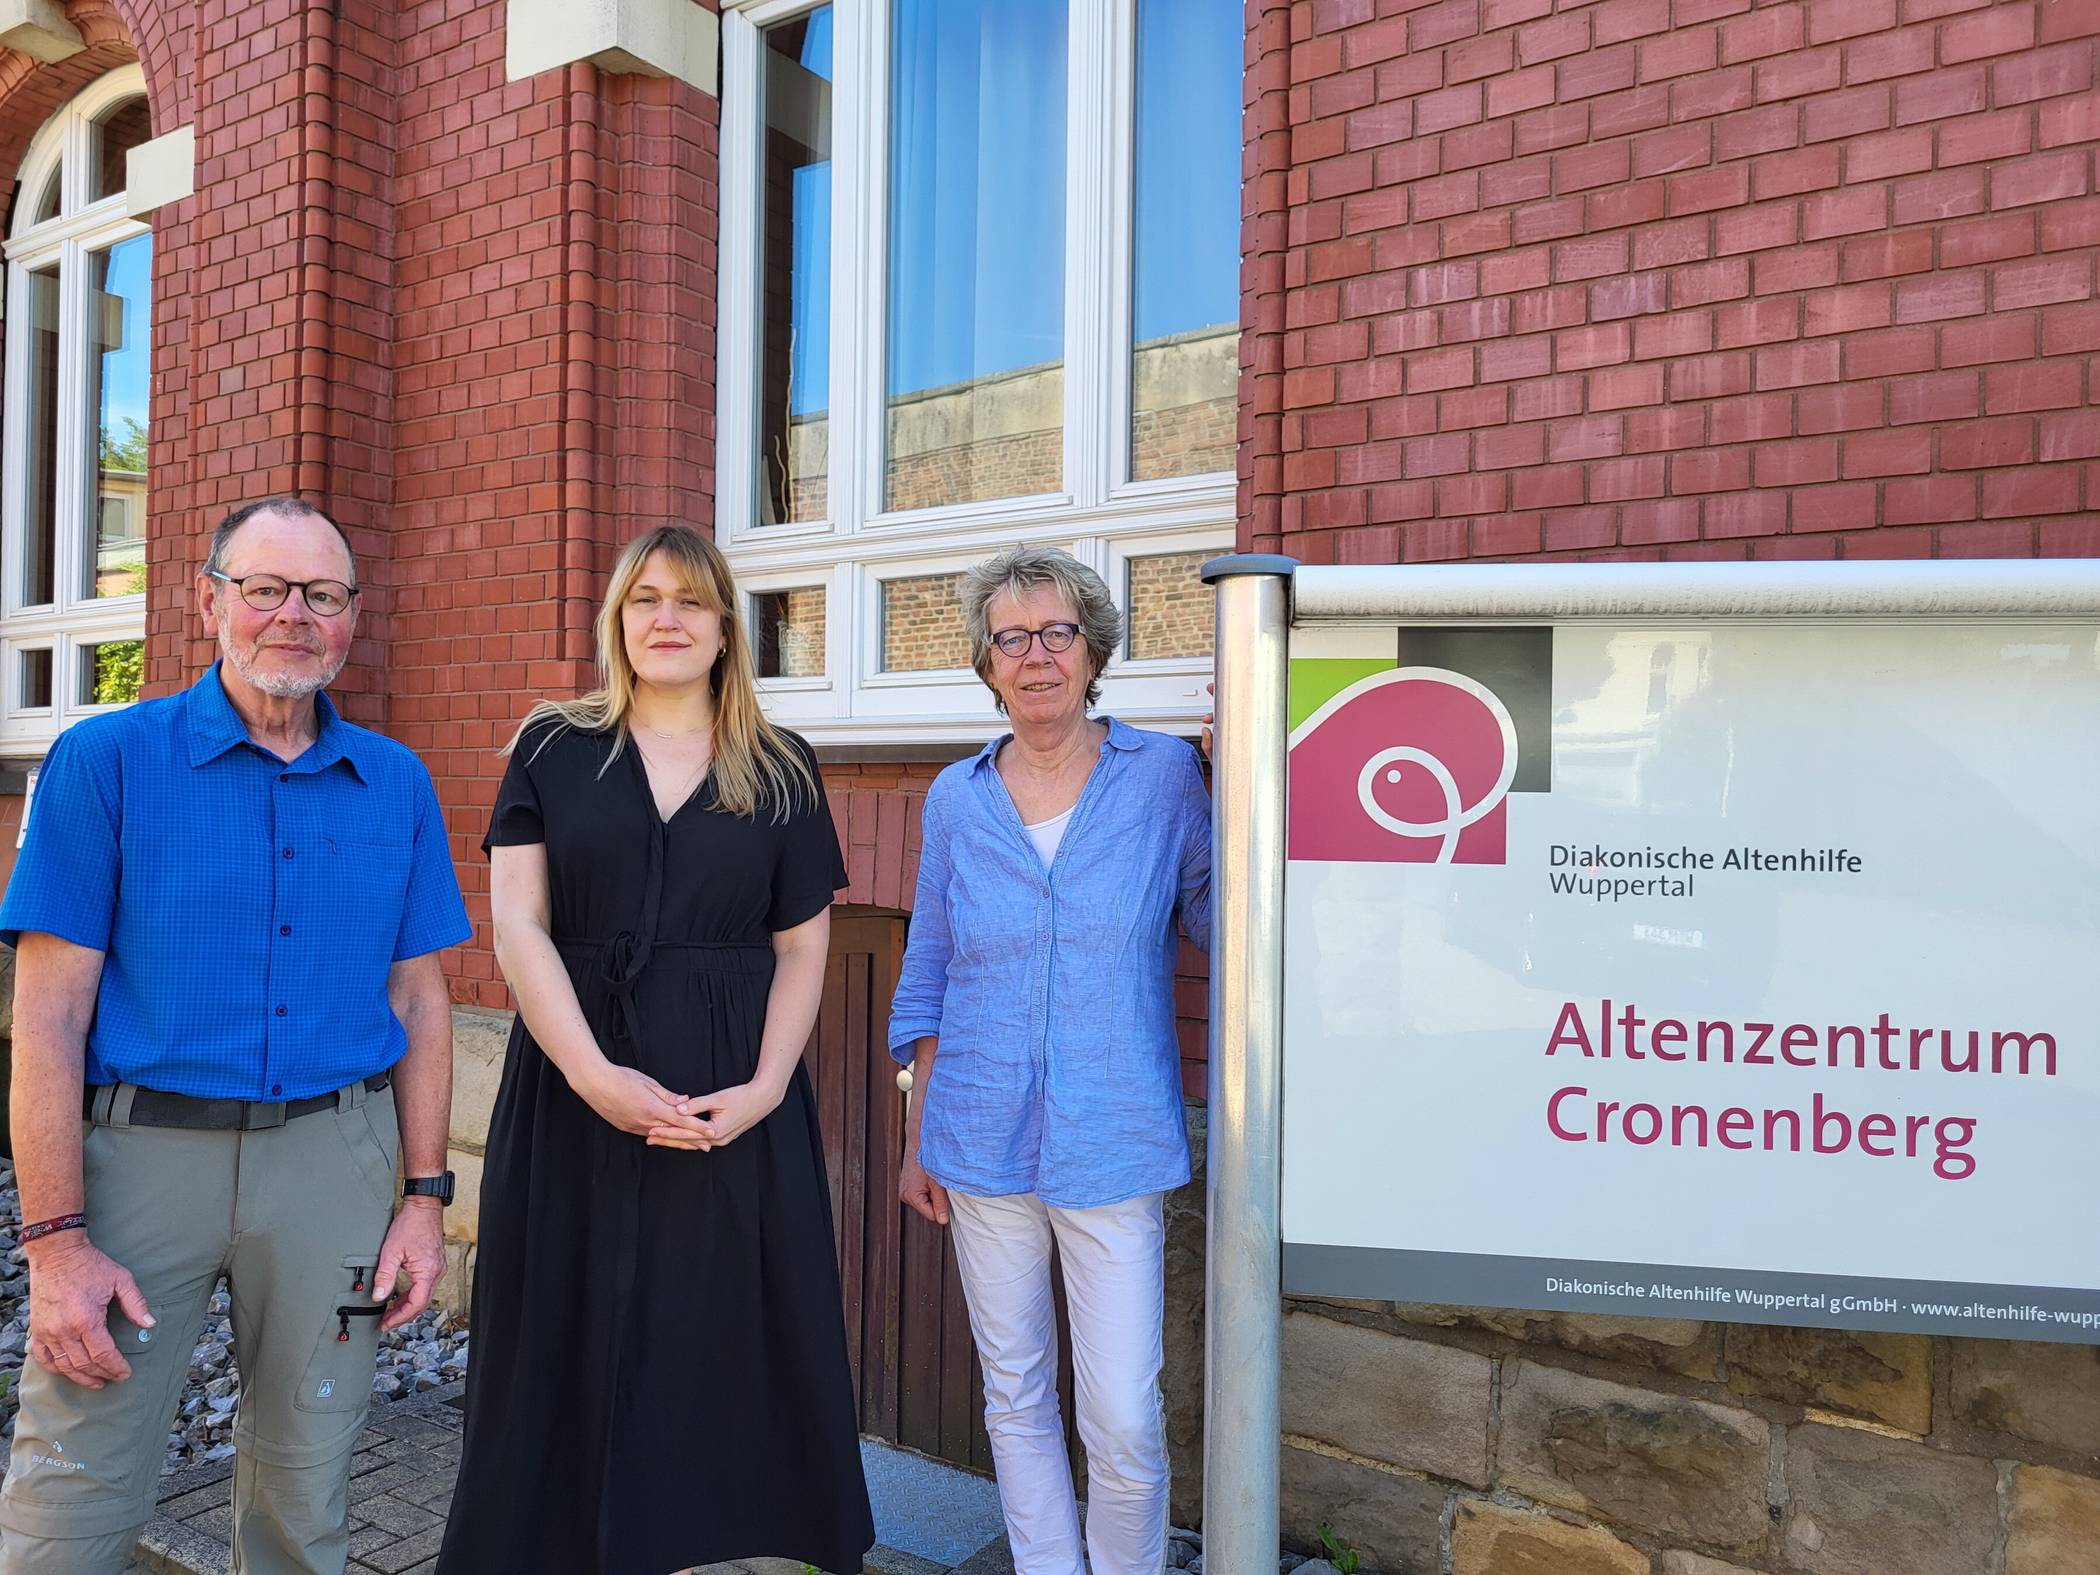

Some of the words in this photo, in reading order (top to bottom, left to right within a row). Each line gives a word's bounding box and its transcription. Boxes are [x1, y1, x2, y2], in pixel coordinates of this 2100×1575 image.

[1550, 845, 1714, 870] Diakonische
[1723, 848, 1861, 873] Altenhilfe
[1550, 873, 1693, 902] Wuppertal
[1545, 999, 2056, 1075] Altenzentrum
[1547, 1086, 1977, 1180] Cronenberg
[1546, 1277, 1645, 1298] Diakonische
[1648, 1283, 1732, 1303] Altenhilfe
[1734, 1288, 1825, 1311] Wuppertal
[1829, 1294, 1897, 1314] gGmbH
[31, 1455, 85, 1470] BERGSON
